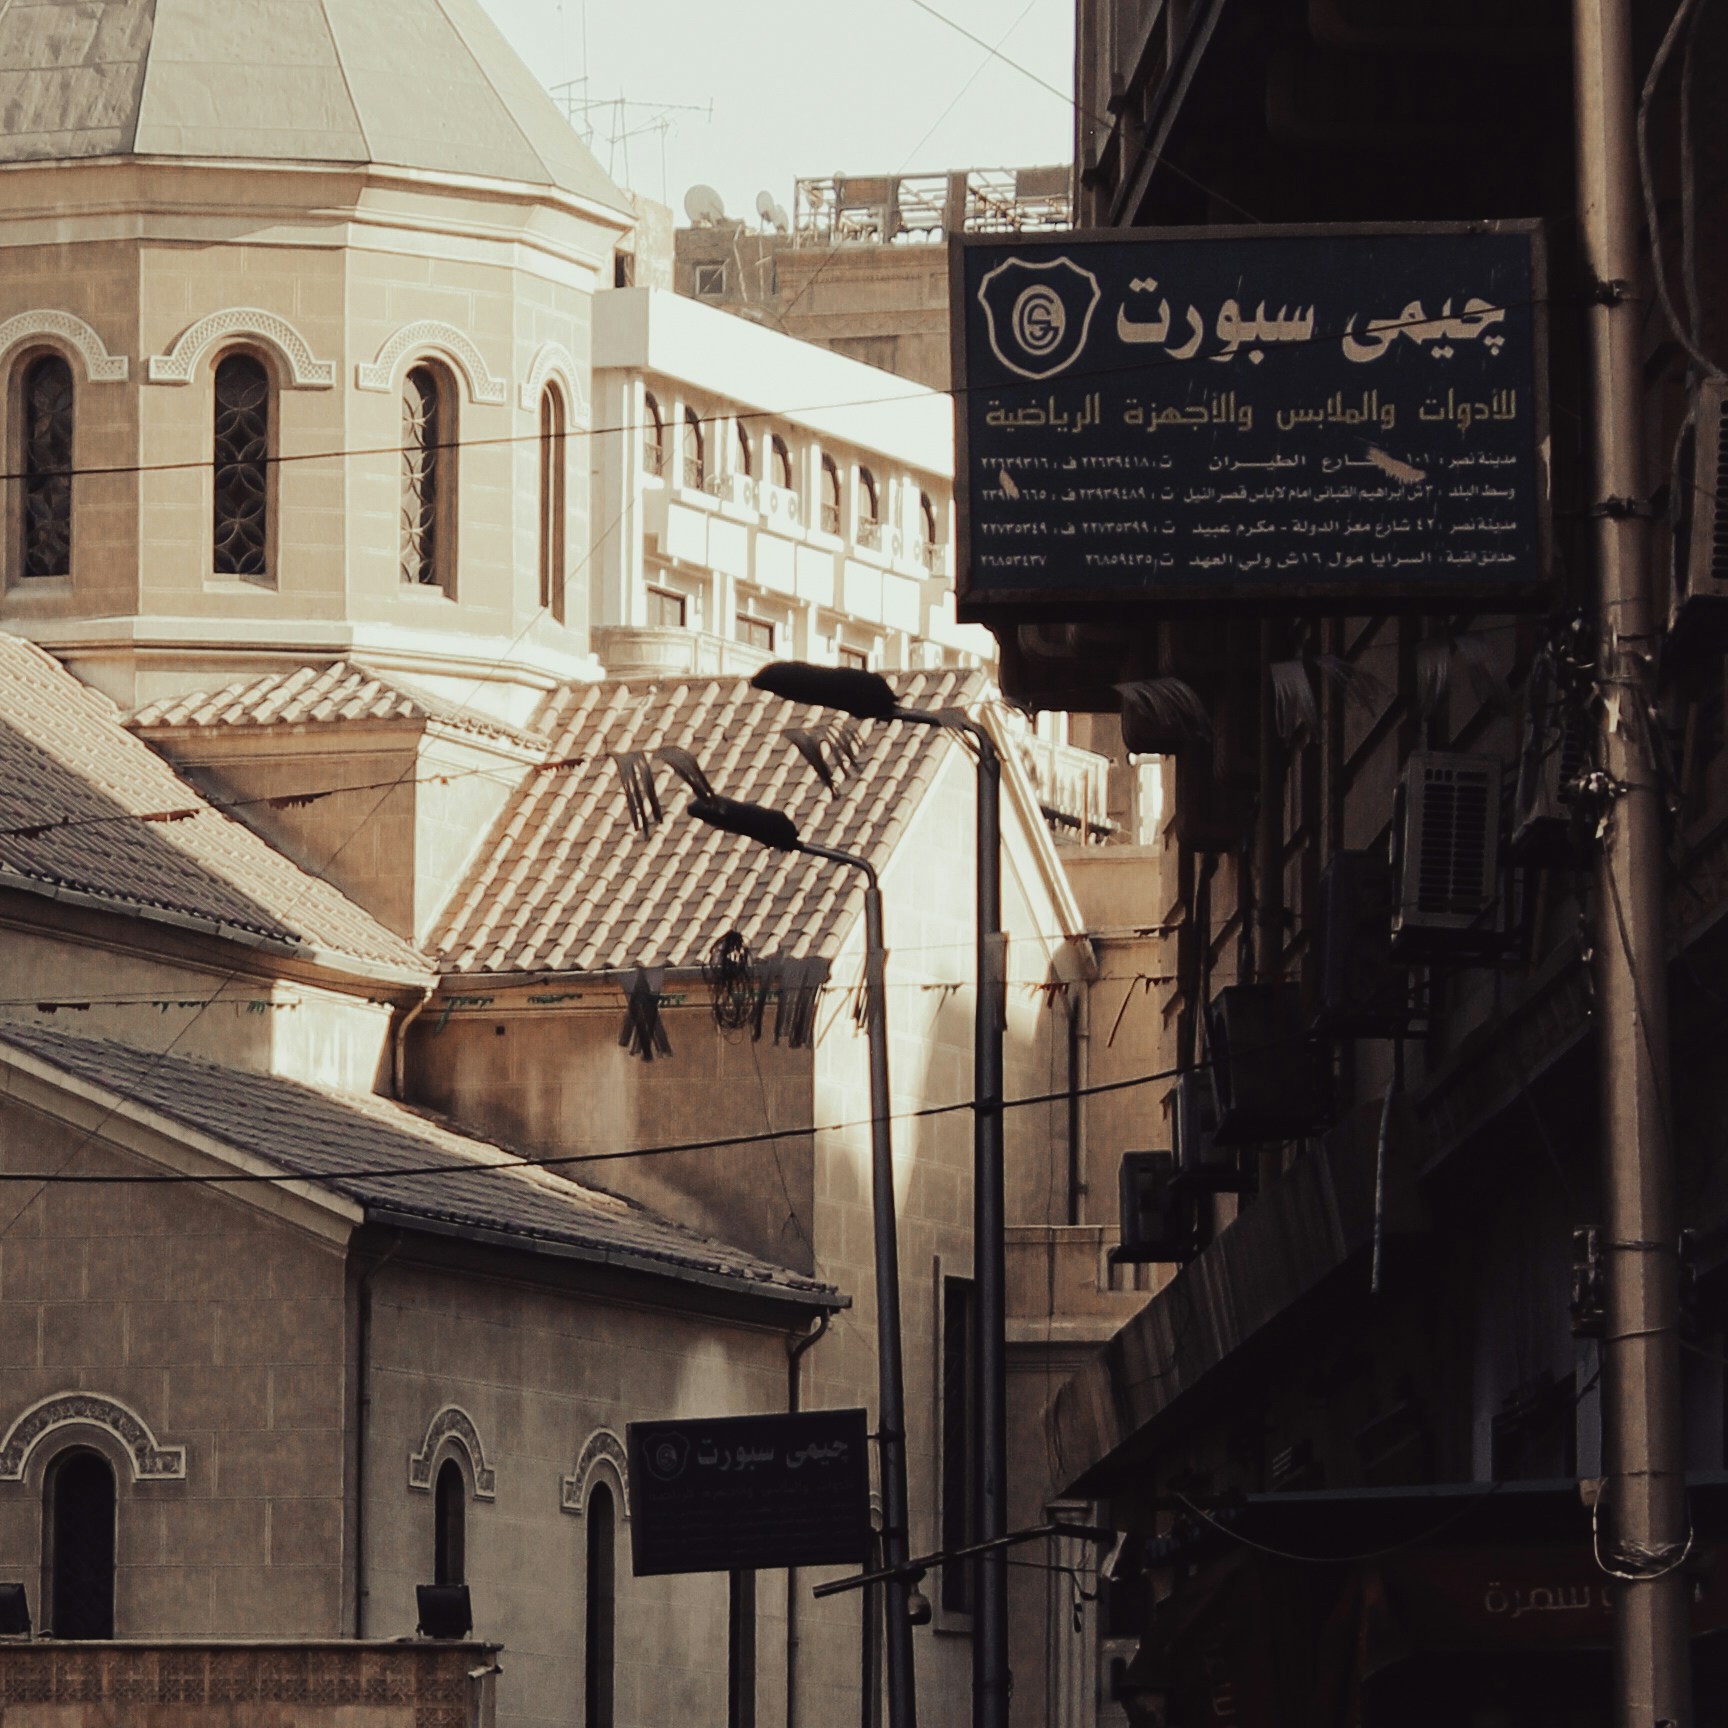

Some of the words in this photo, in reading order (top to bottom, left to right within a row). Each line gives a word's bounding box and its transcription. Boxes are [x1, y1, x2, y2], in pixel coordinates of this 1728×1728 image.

[1116, 275, 1316, 367] سبورت
[982, 392, 1104, 436] الرياضية
[1121, 388, 1255, 434] والأجهزة
[1274, 385, 1398, 434] والملابس
[1479, 452, 1516, 467] مدينة
[1481, 483, 1516, 502] وسط
[1478, 516, 1518, 535] مدينة
[1328, 551, 1364, 568] مول
[697, 1438, 775, 1472] سبورت
